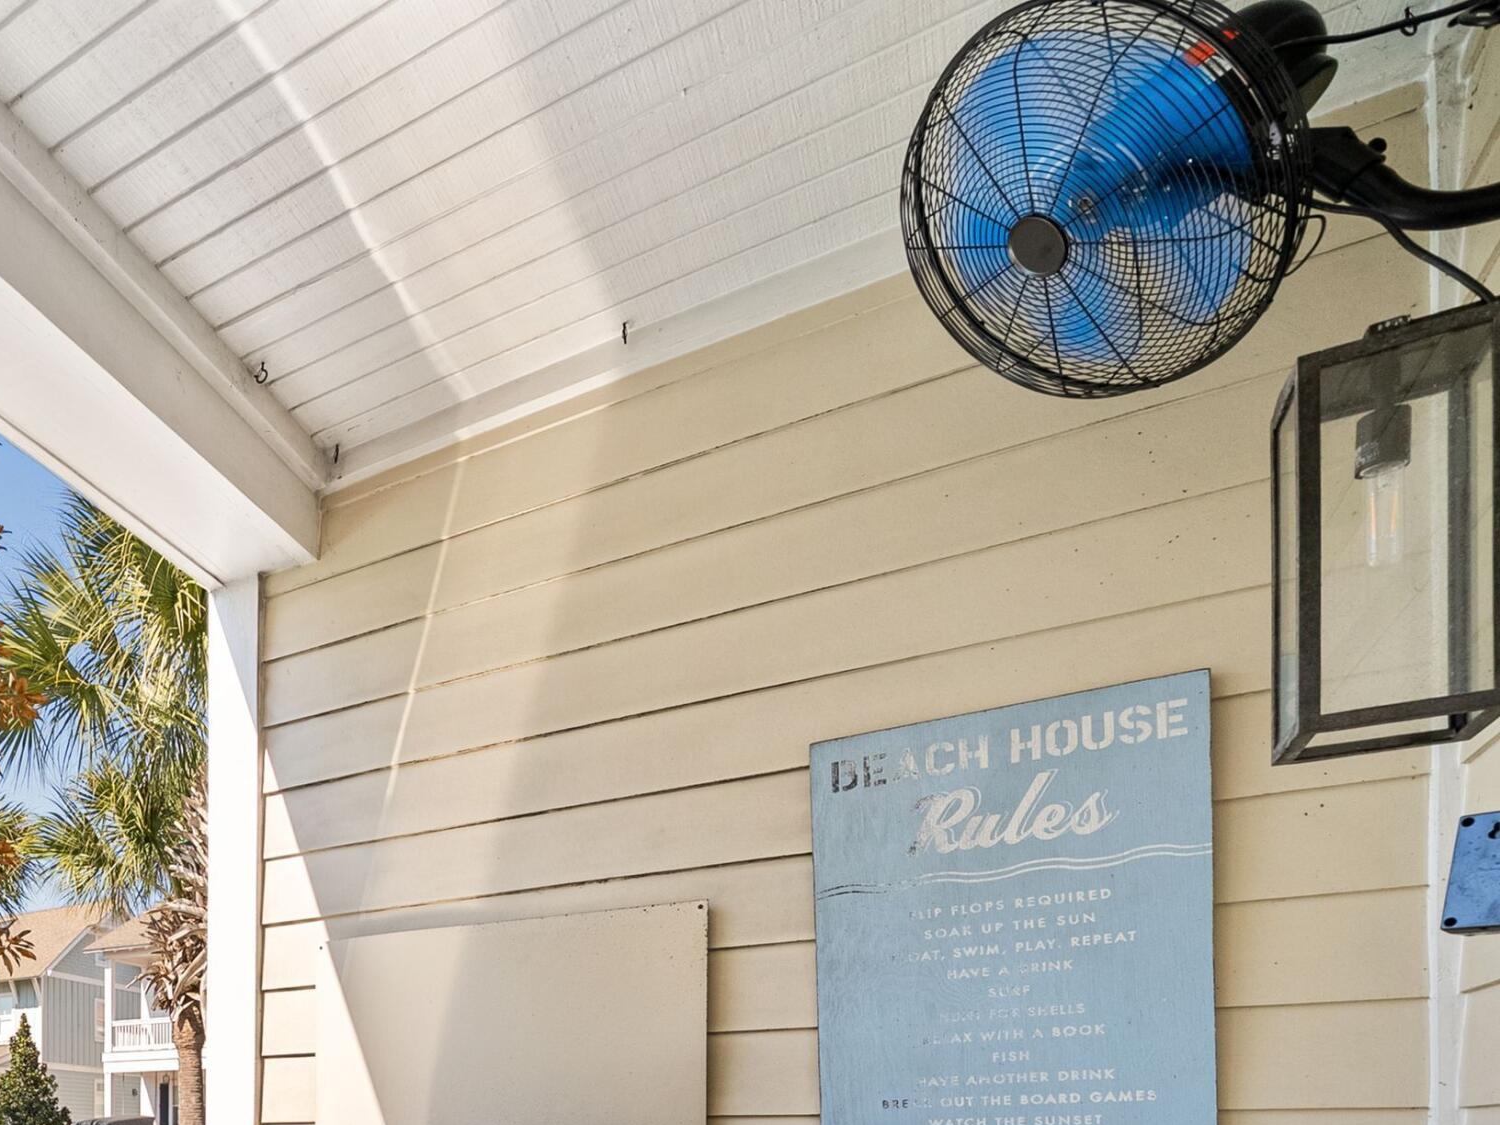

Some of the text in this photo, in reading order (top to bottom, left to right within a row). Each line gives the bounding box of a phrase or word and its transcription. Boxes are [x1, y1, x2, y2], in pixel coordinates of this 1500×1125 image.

[831, 697, 1189, 794] BEACH HOUSE
[904, 768, 1120, 858] Rules
[951, 900, 1006, 917] FLOPS
[1014, 888, 1112, 909] REQUIRED
[924, 912, 1097, 940] SOAK UP THE SUN
[1070, 930, 1138, 947] REPEAT
[947, 966, 990, 980] HAVE
[998, 966, 1010, 977] A
[1027, 1003, 1086, 1017] SHELLS
[980, 1029, 1024, 1042] WITH
[1032, 1027, 1044, 1039] A
[1051, 1024, 1106, 1038] BOOK
[992, 1051, 1031, 1063] FISH
[965, 1071, 1049, 1086] ANOTHER
[1058, 1068, 1116, 1082] DRINK
[940, 1096, 974, 1108] OUT
[981, 1094, 1012, 1107] THE
[1019, 1092, 1081, 1106] BOARD
[1089, 1089, 1157, 1104] GAMES
